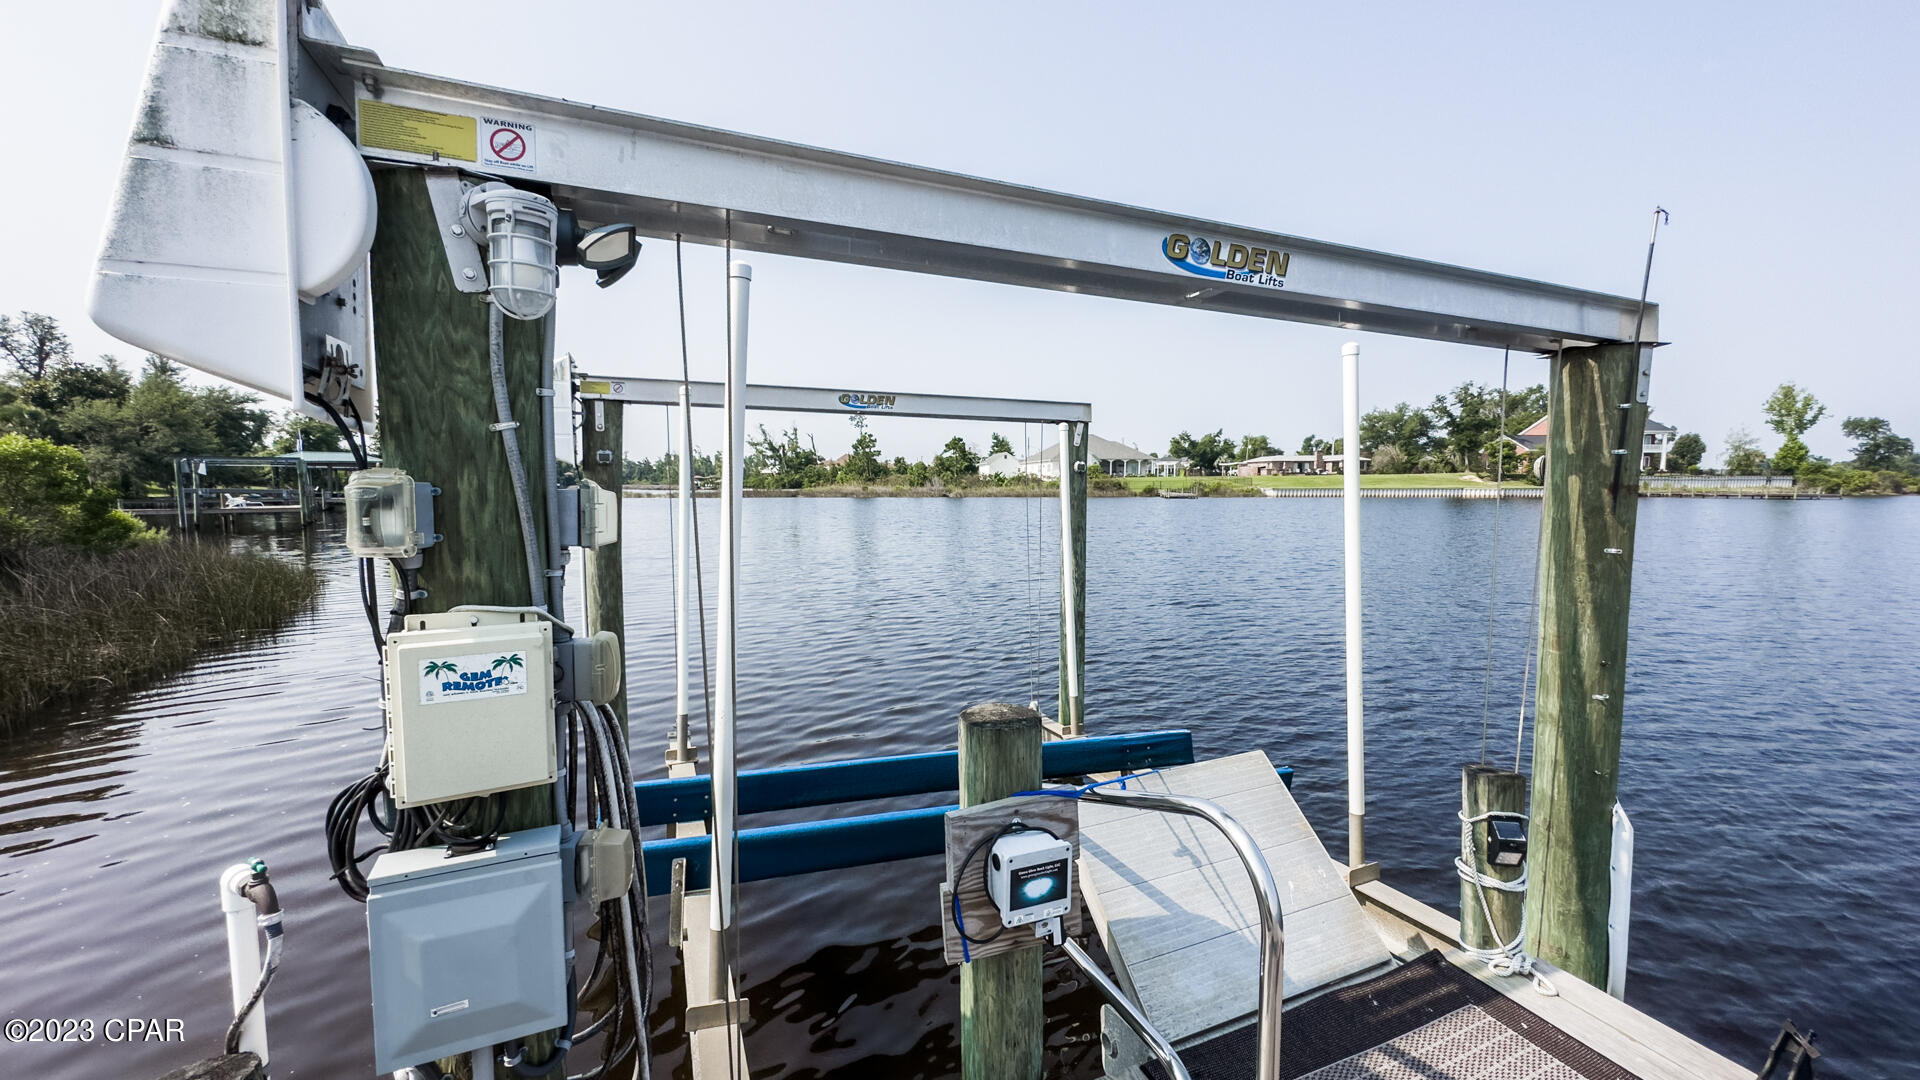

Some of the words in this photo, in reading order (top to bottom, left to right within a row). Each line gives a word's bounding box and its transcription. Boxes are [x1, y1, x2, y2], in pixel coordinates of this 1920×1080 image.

[483, 118, 532, 131] WARNING
[1166, 233, 1290, 277] GOLDEN
[1226, 269, 1255, 283] Boat
[1258, 274, 1284, 288] Lifts
[841, 393, 896, 406] GOLDEN
[459, 669, 493, 682] GEM
